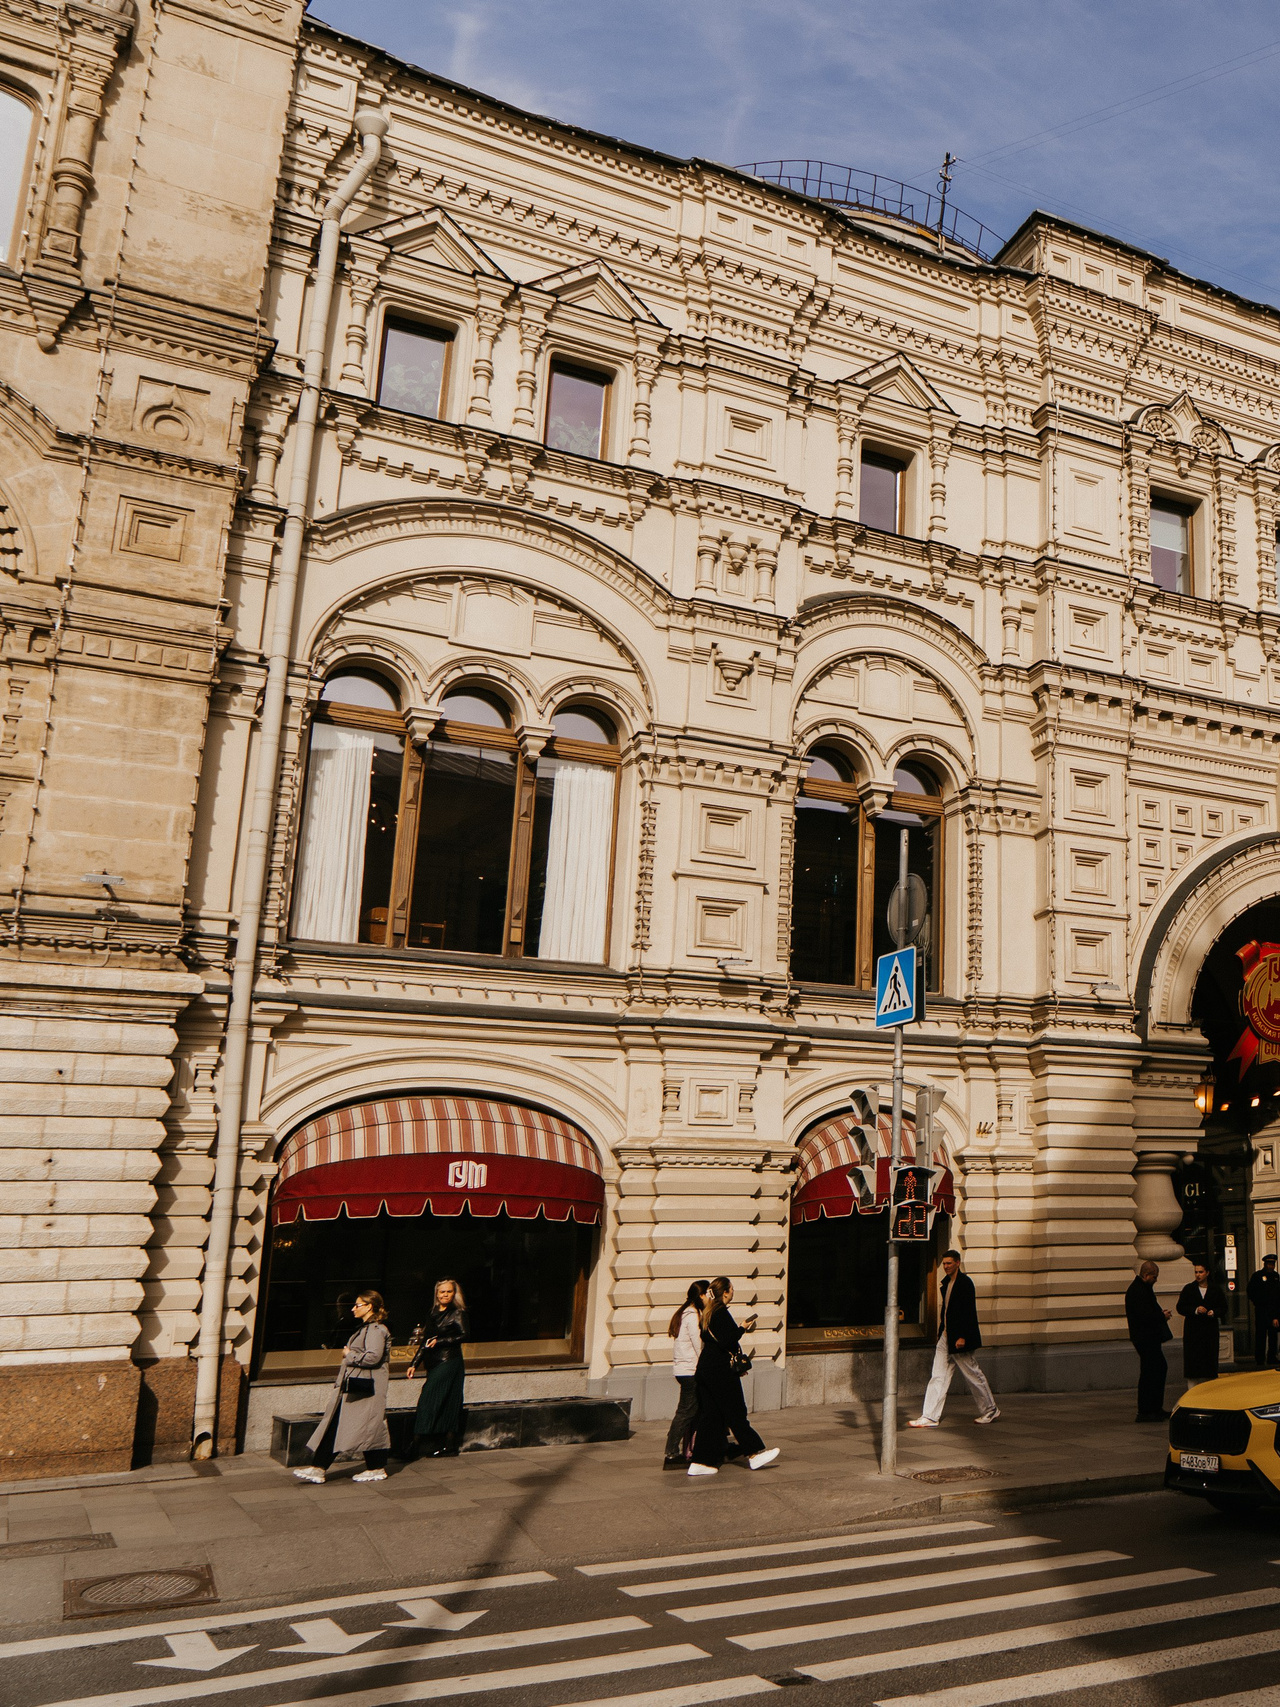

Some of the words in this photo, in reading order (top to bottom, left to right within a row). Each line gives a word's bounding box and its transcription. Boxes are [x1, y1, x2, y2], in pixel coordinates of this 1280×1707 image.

[1252, 1011, 1277, 1038] КРАСНАЯ
[447, 1160, 488, 1190] ГУМ
[898, 1205, 926, 1237] 22
